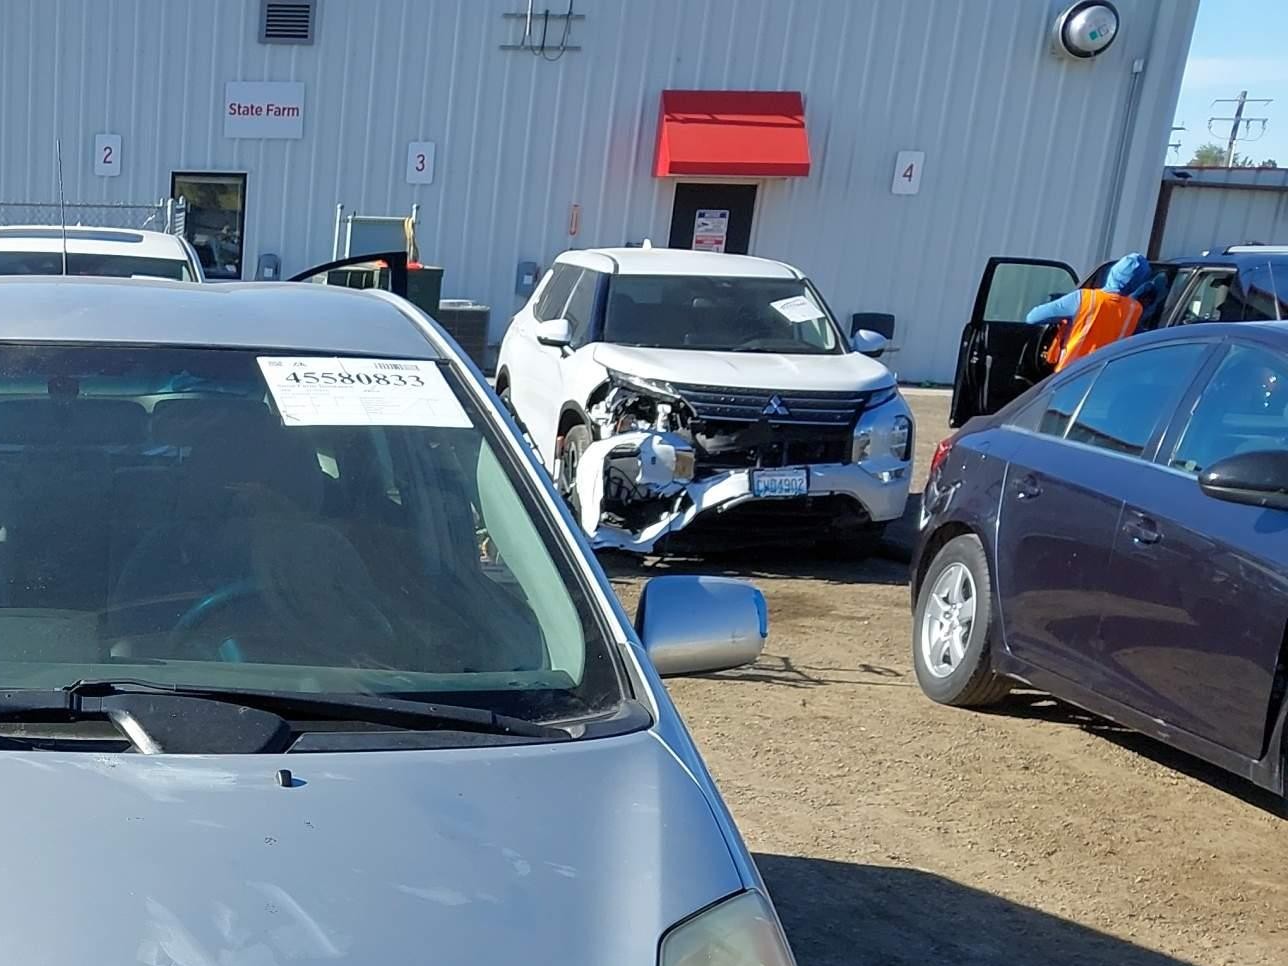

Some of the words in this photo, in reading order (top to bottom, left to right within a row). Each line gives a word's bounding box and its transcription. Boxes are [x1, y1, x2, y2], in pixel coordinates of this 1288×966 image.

[229, 103, 263, 116] State
[266, 104, 299, 117] Farm
[103, 146, 113, 164] 2
[415, 153, 425, 172] 3
[902, 163, 914, 182] 4
[285, 371, 425, 388] 45580833
